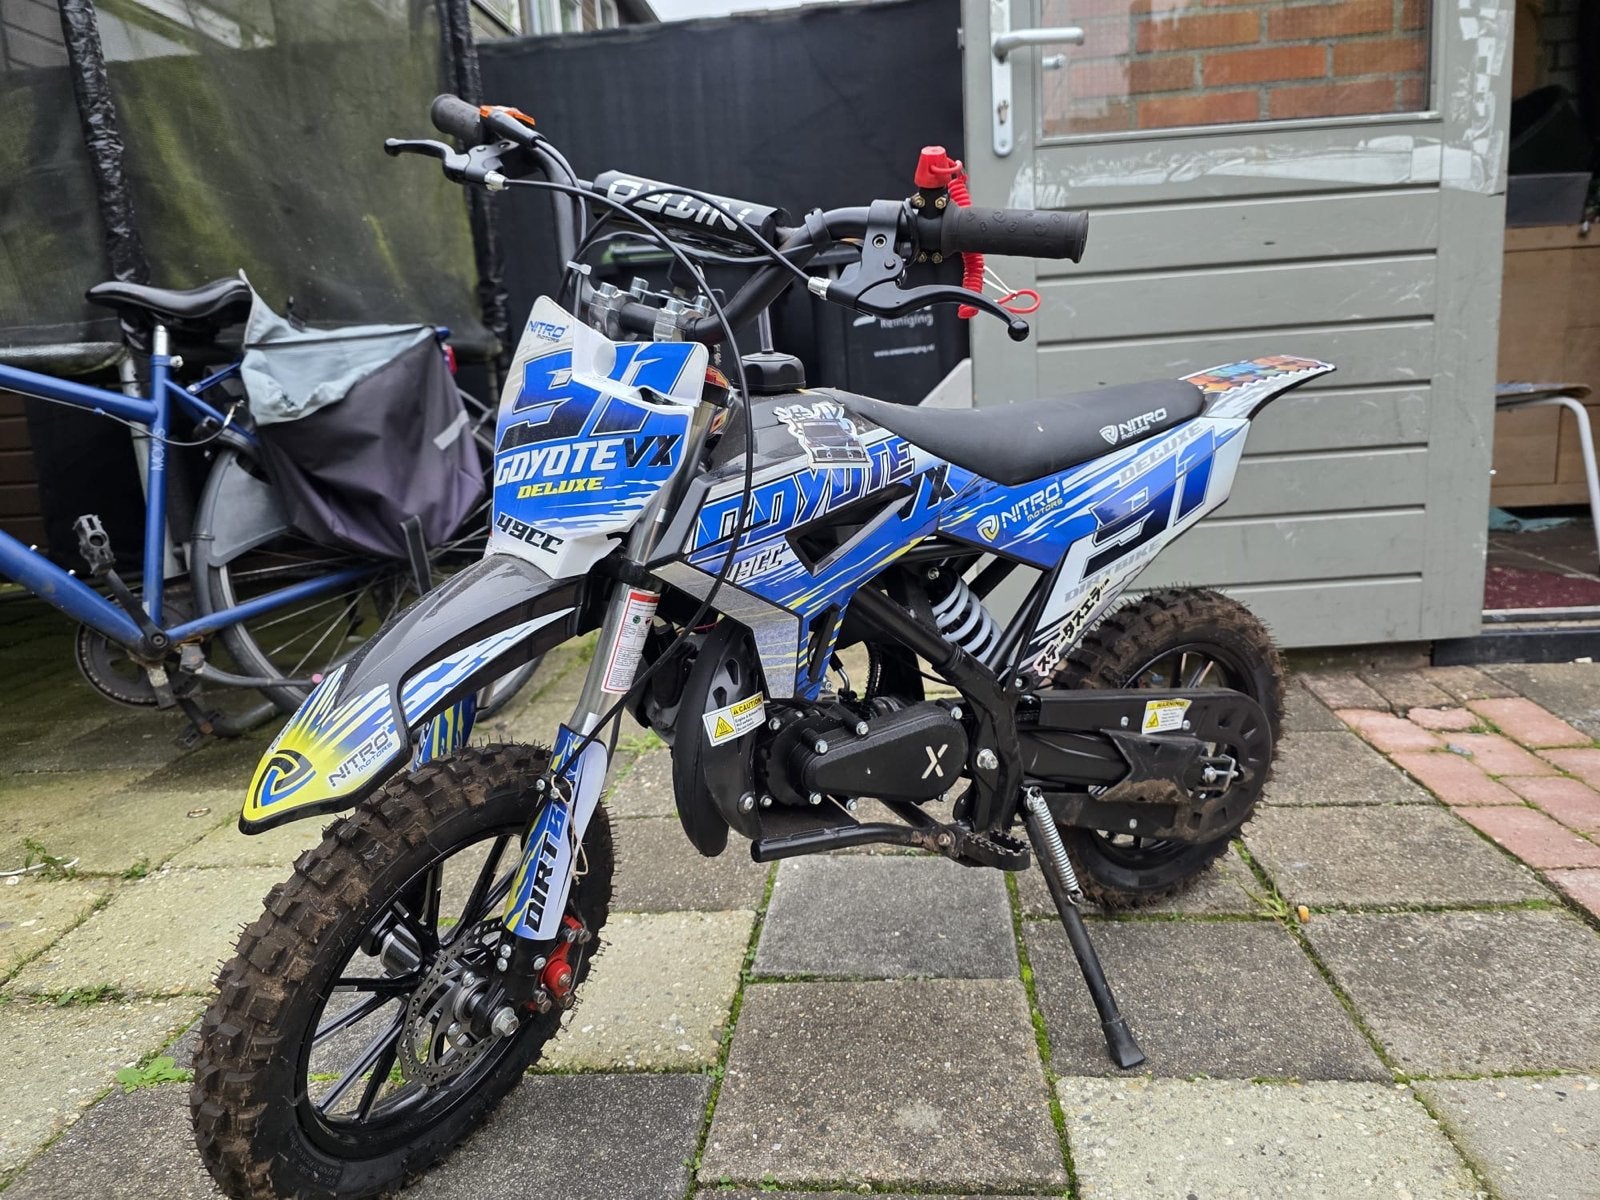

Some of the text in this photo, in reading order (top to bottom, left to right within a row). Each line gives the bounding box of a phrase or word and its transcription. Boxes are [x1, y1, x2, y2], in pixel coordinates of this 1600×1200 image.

[607, 178, 752, 232] NITRO
[526, 320, 566, 338] NITRO
[1117, 407, 1167, 436] NITRO
[623, 434, 683, 469] VX
[1118, 421, 1203, 483] DELUXE
[516, 476, 605, 499] DELUXE
[1000, 481, 1060, 529] NITRO
[1026, 498, 1063, 523] MOTORS
[495, 511, 565, 555] 49CC
[738, 697, 762, 713] CAUTION
[327, 729, 390, 788] NITRO
[357, 741, 394, 773] MOTORS
